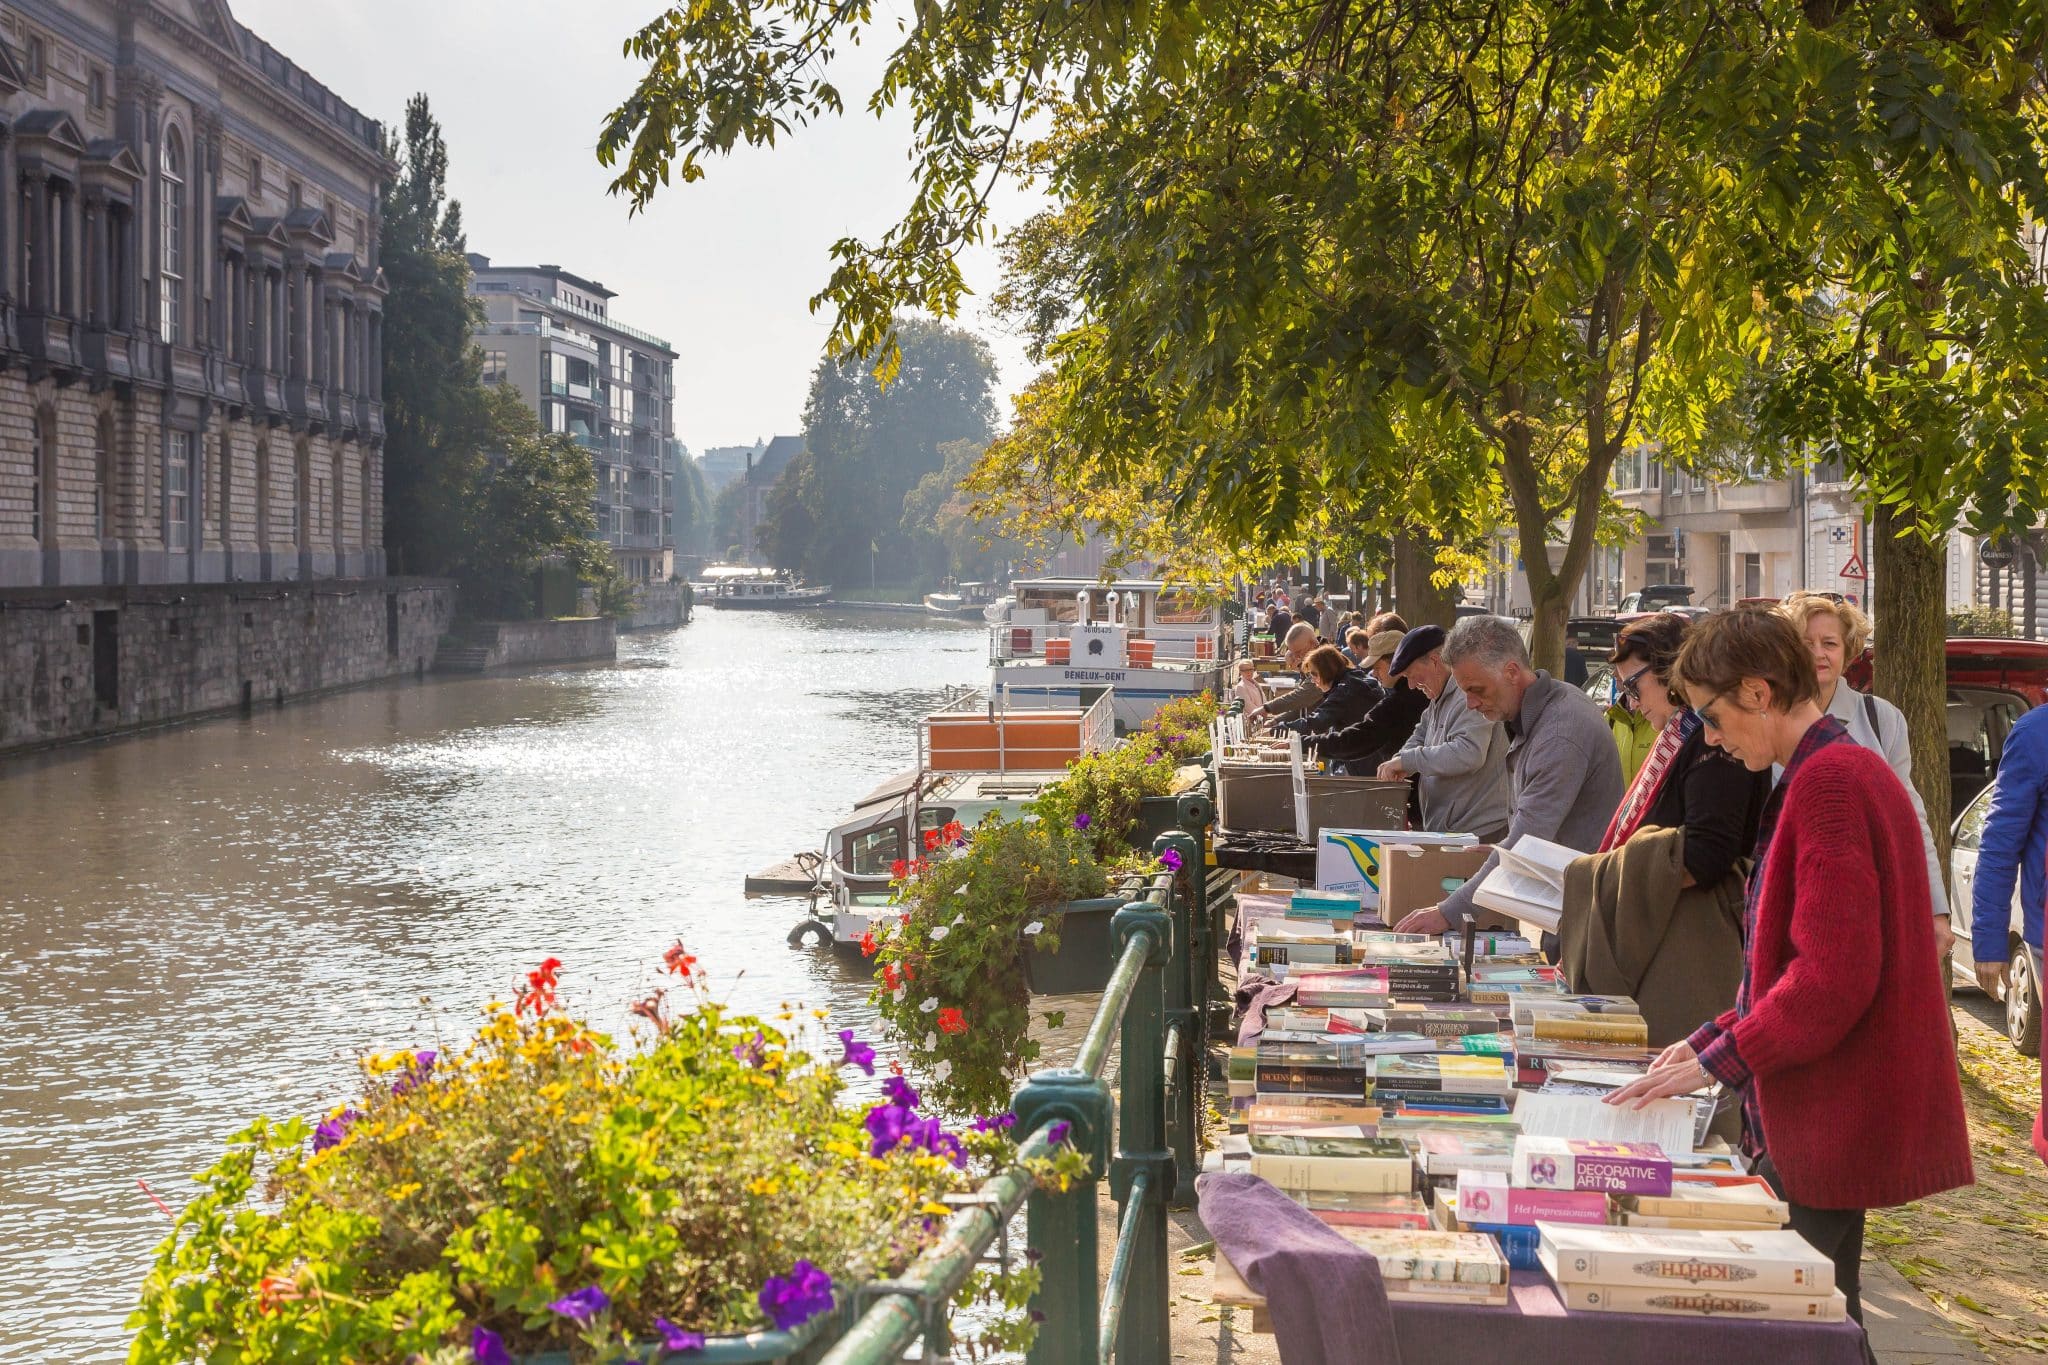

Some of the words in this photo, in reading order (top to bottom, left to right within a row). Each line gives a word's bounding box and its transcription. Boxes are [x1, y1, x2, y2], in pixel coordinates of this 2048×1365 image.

[1474, 993, 1488, 1001] THE
[1261, 1072, 1290, 1082] DICKENS
[1577, 1162, 1656, 1180] DECORATIVE
[1576, 1175, 1601, 1188] ART
[1604, 1179, 1627, 1190] 70s
[1514, 1204, 1531, 1215] Het
[1532, 1205, 1601, 1219] Impressionisme
